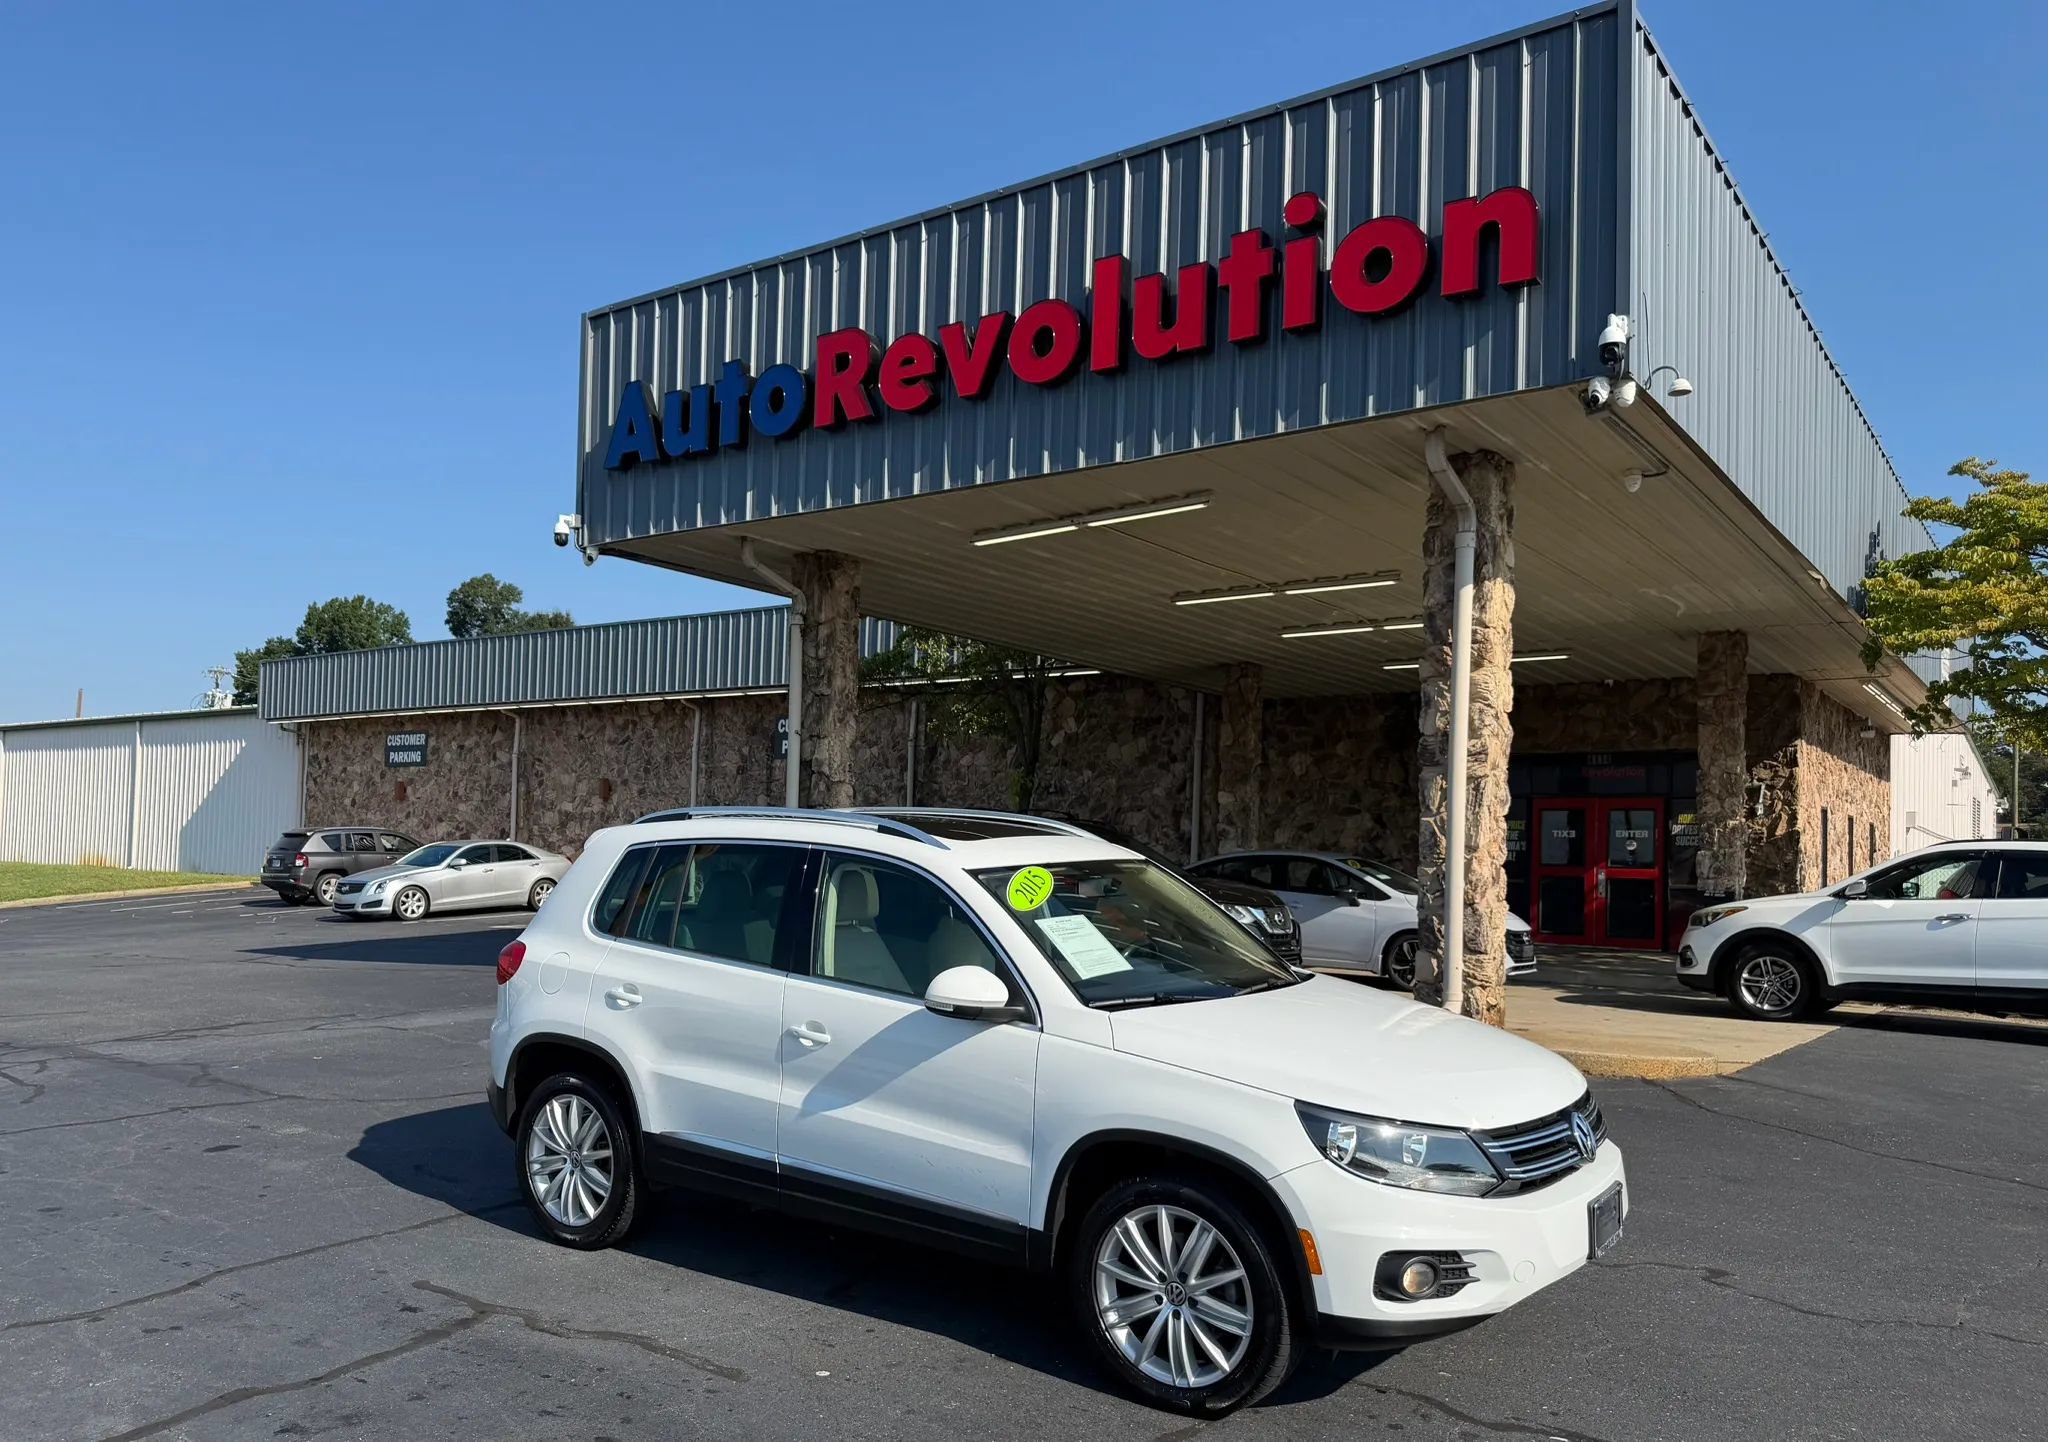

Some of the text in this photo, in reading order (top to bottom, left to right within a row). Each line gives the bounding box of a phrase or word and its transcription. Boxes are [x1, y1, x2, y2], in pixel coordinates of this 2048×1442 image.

[387, 733, 426, 746] CUSTOMER
[389, 750, 421, 763] PARKING
[1615, 830, 1649, 838] ENTER
[1015, 870, 1046, 905] 2015
